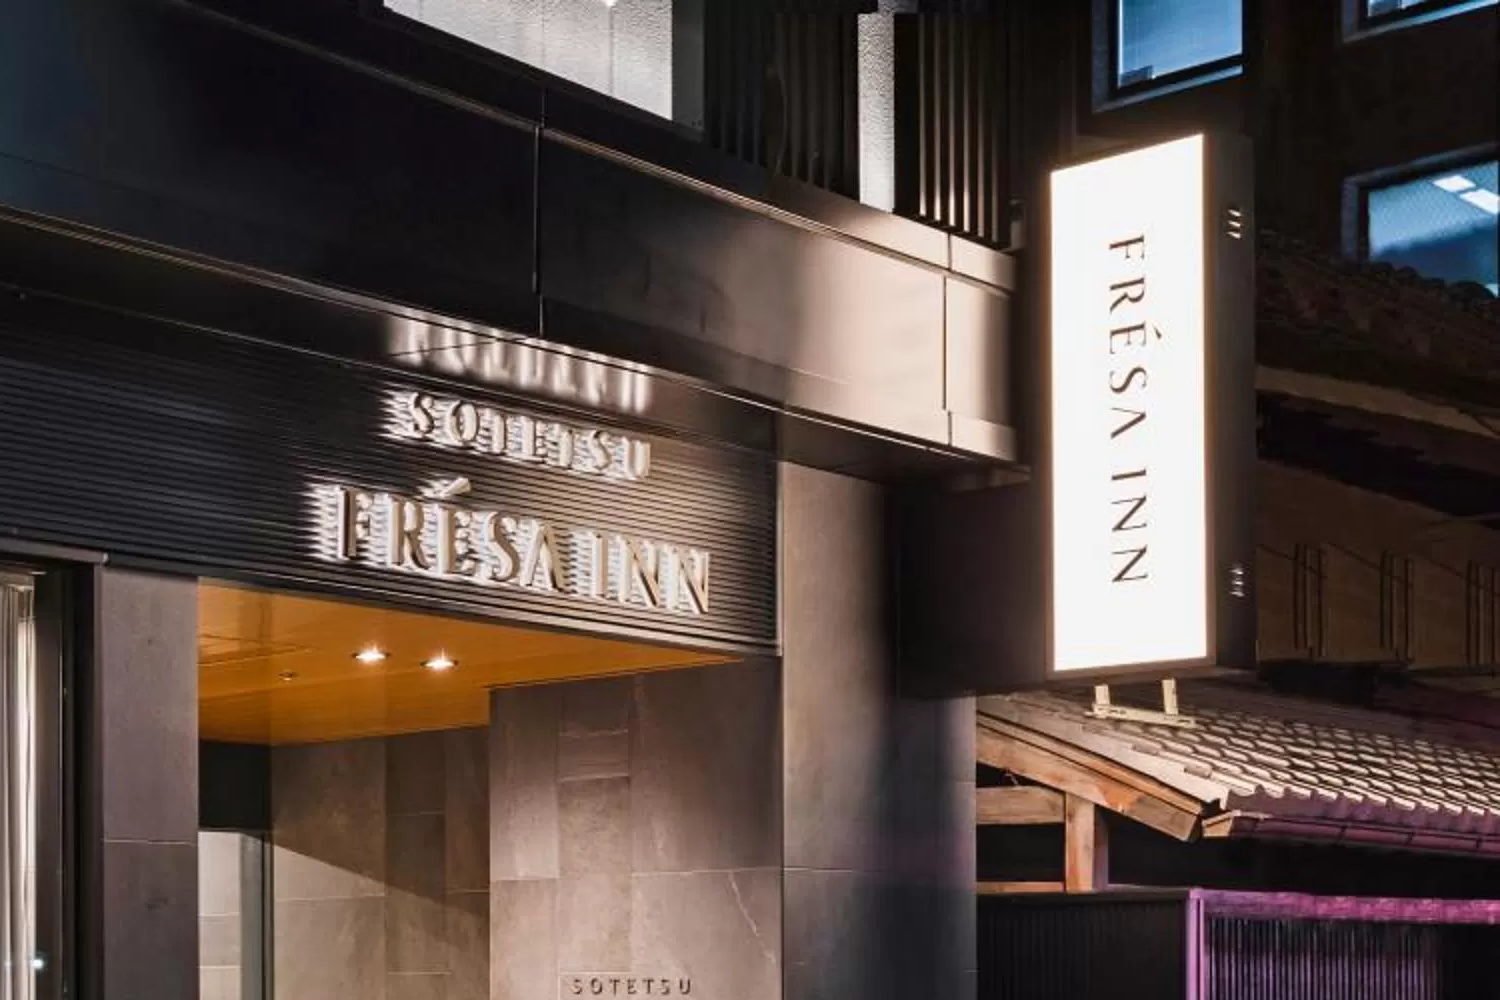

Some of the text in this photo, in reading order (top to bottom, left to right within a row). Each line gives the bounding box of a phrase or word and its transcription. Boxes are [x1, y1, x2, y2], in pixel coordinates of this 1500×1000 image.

[409, 390, 652, 481] SOTETSU
[1108, 234, 1163, 583] FRÉSA INN
[334, 476, 710, 615] FRÉSA INN
[572, 978, 692, 996] SOTETSU
